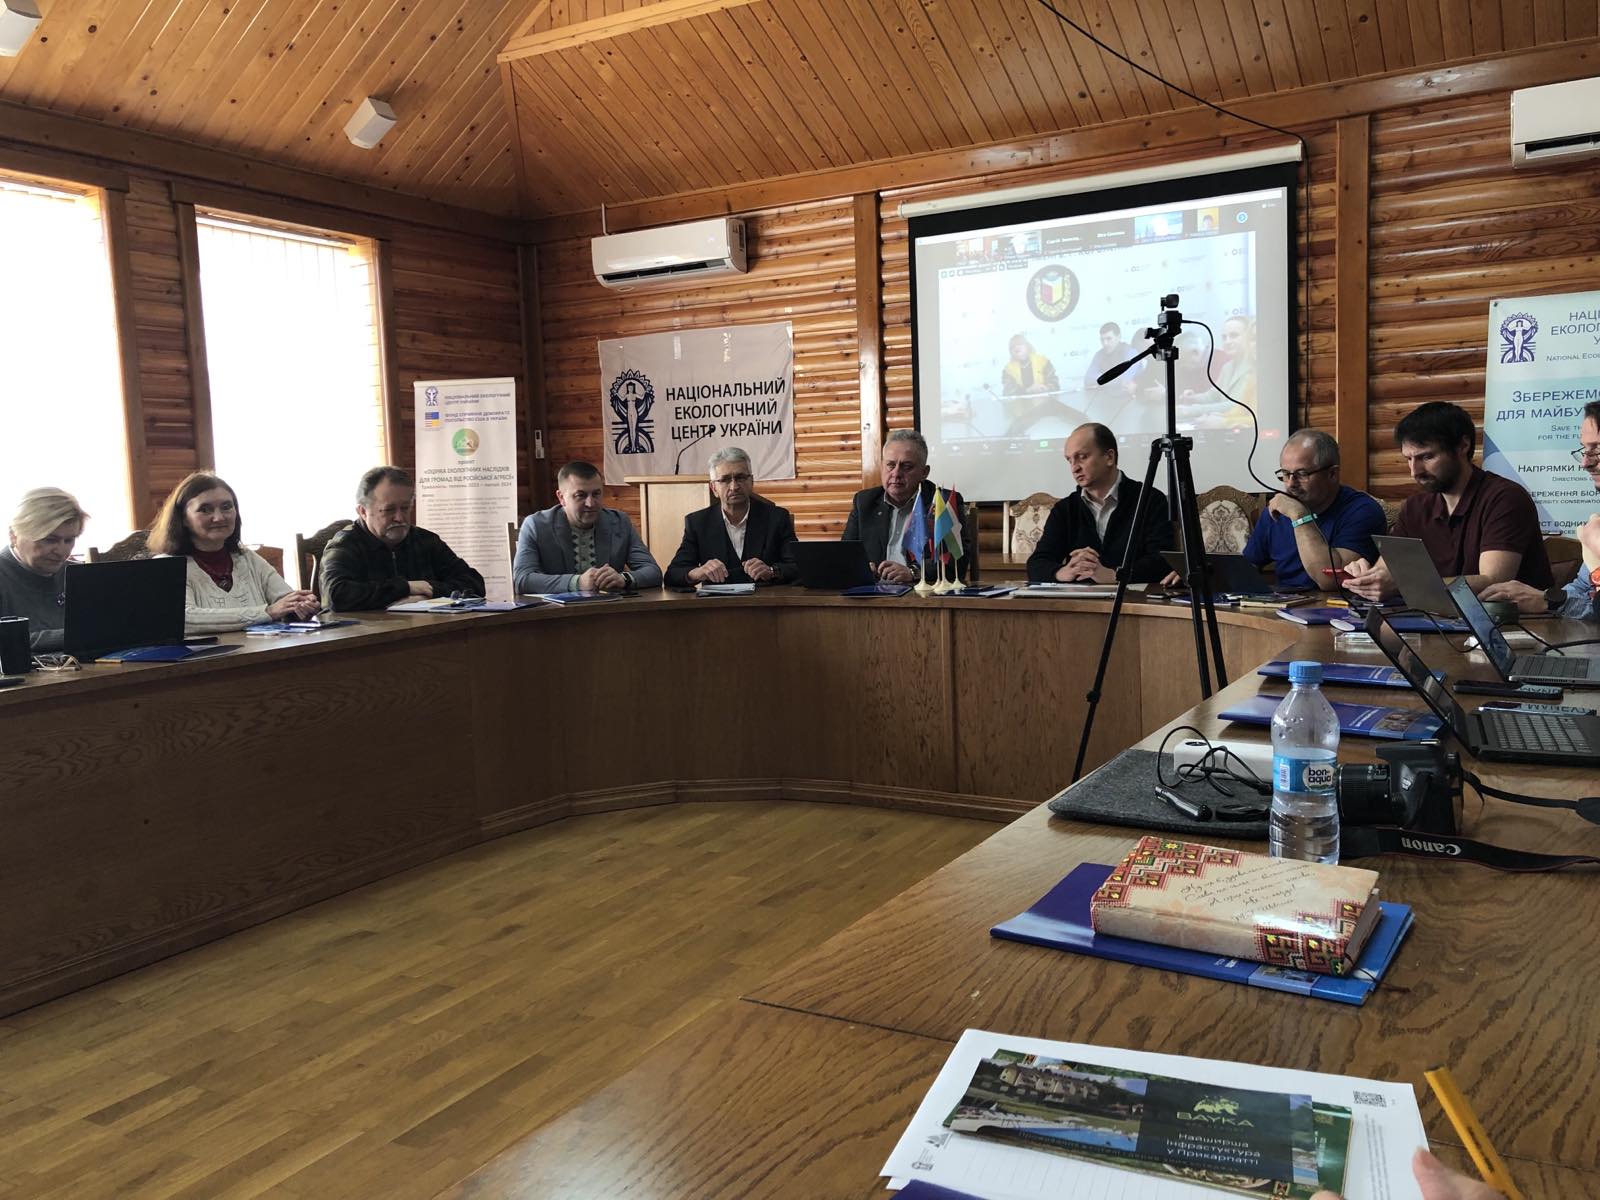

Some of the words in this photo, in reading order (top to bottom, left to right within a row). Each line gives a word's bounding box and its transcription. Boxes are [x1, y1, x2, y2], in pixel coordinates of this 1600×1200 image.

[666, 377, 786, 402] НАЦІОНАЛЬНИЙ
[674, 398, 778, 420] ЕКОЛОГІЧНИЙ
[1531, 405, 1584, 418] МАЙБУ
[671, 424, 717, 442] ЦЕНТР
[720, 419, 783, 438] УКРАЇНИ
[1531, 490, 1578, 498] ЕРЕЖЕННЯ
[1308, 775, 1332, 785] aqua
[1401, 837, 1462, 856] Canon
